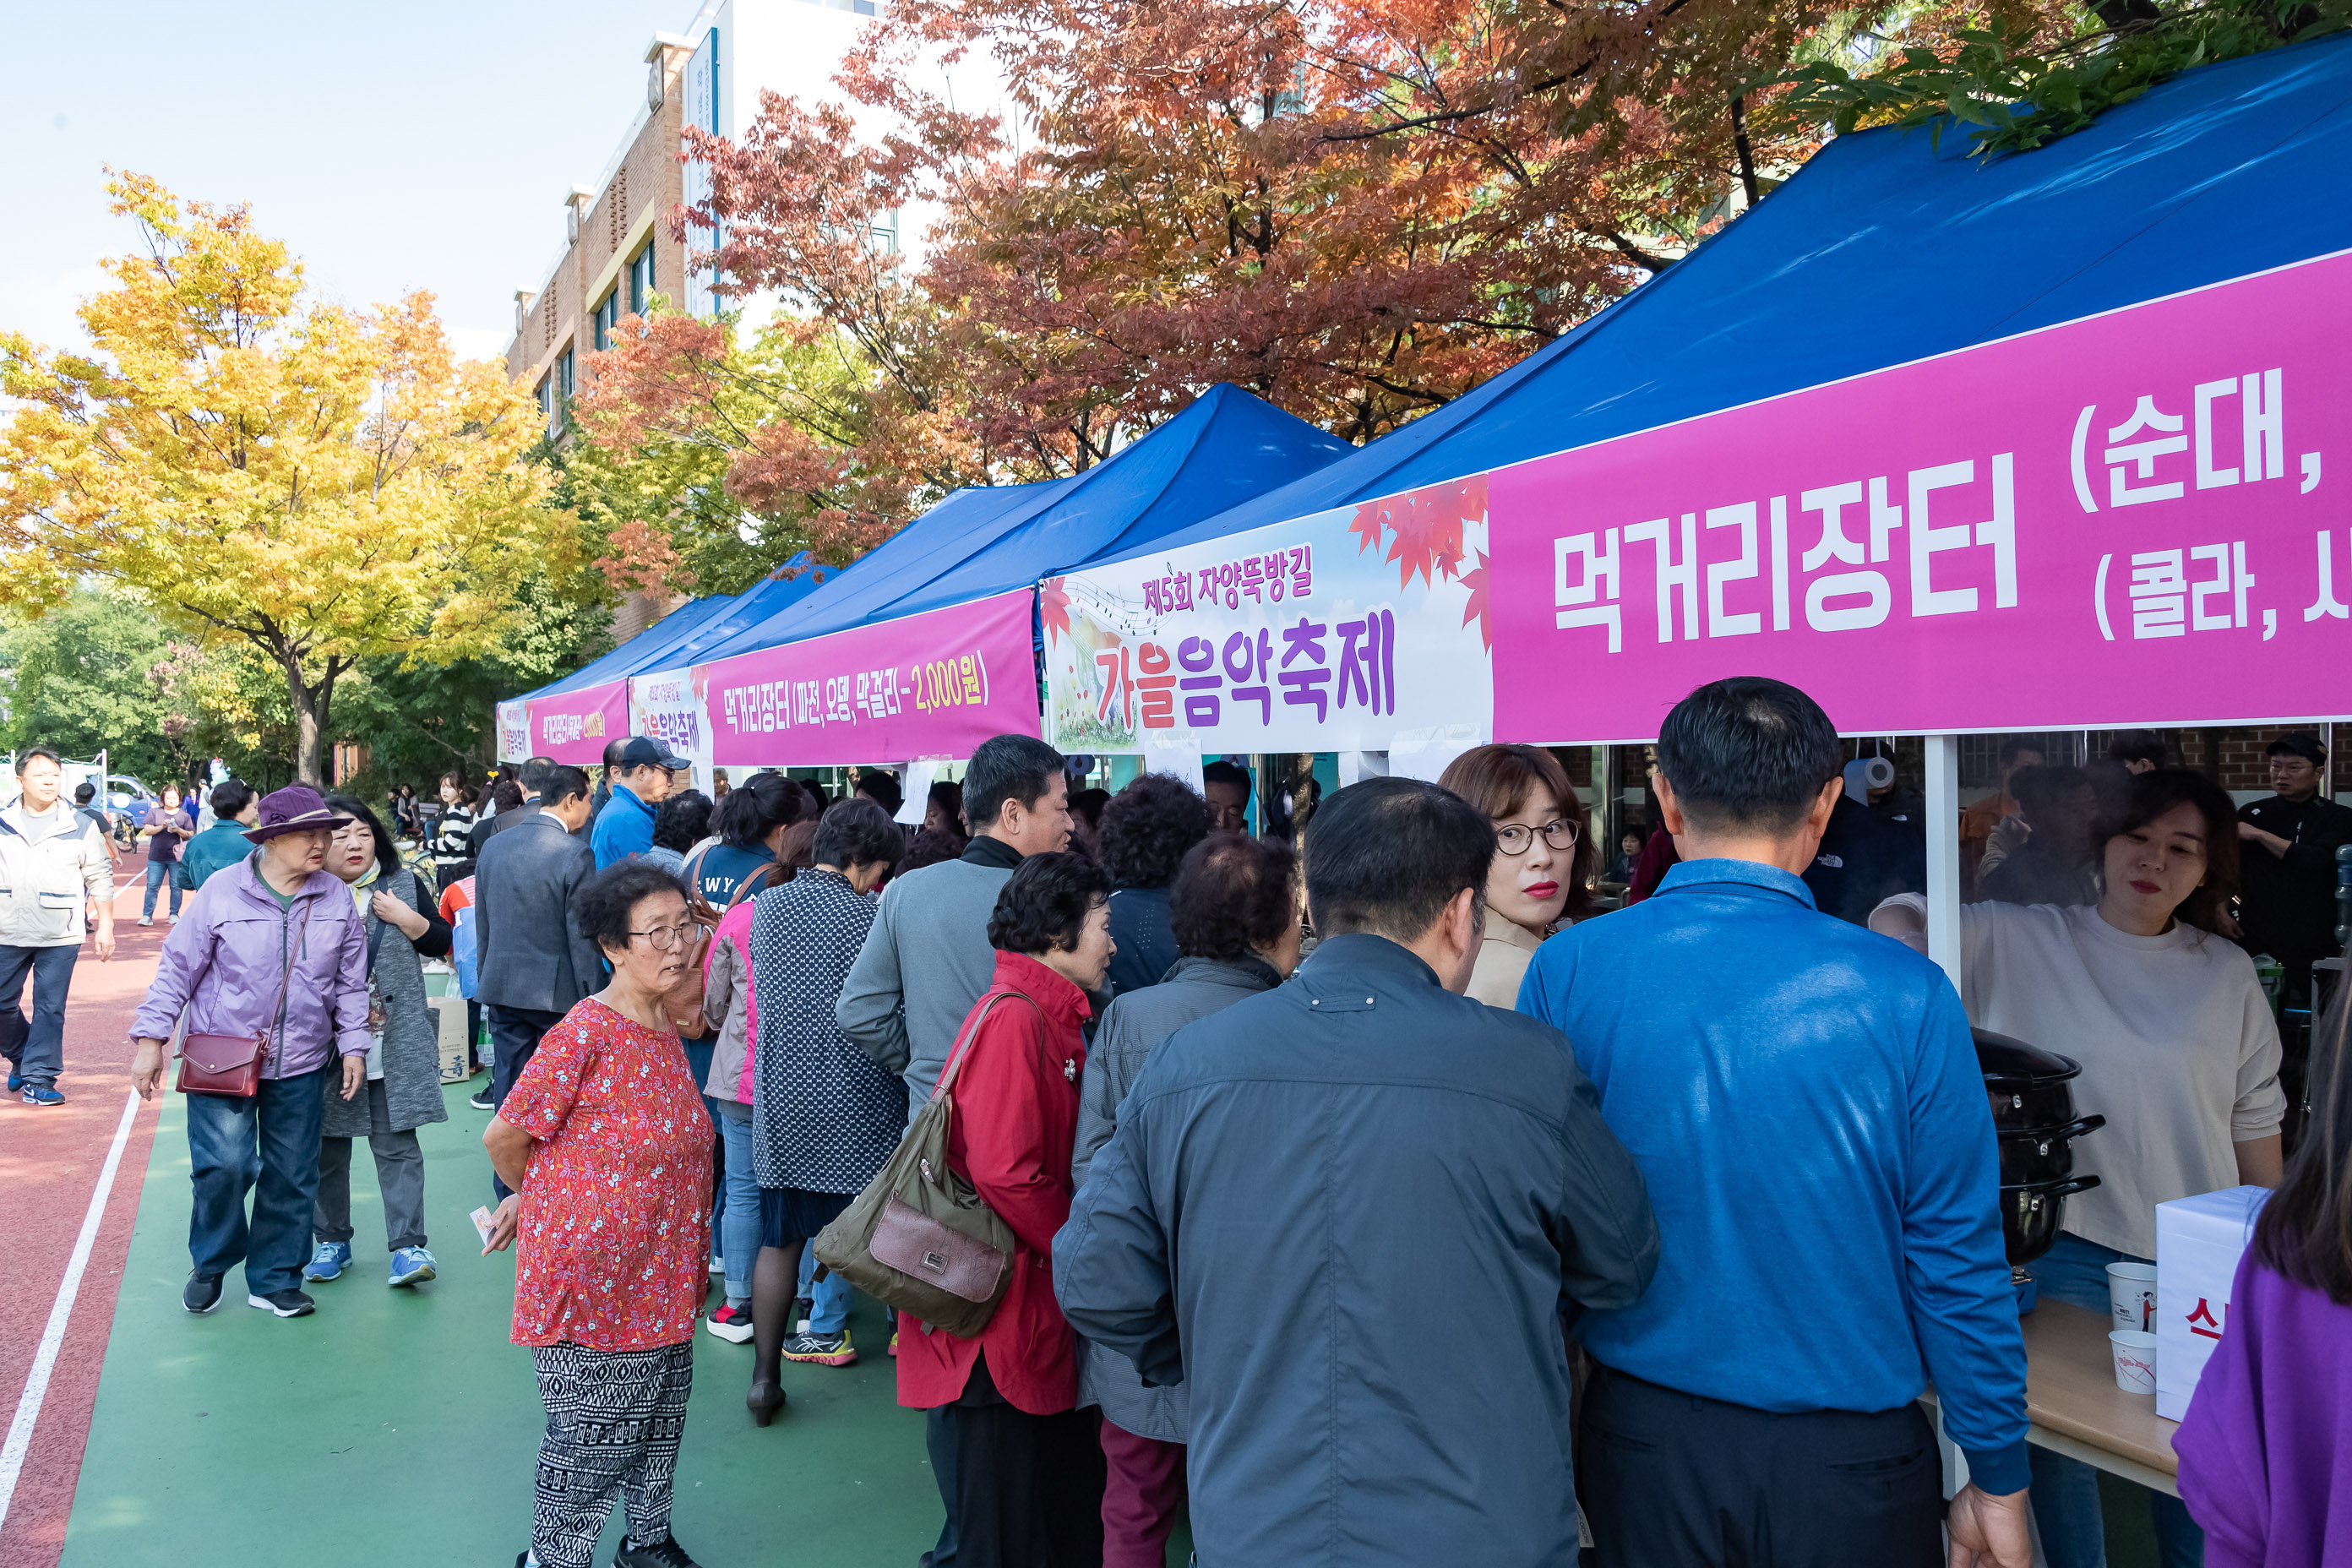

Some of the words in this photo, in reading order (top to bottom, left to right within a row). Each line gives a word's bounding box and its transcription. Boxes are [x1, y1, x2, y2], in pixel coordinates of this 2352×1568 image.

[1143, 572, 1194, 617] 제5회
[1199, 546, 1311, 610] 자양뚝방길
[1554, 451, 2019, 654] 먹거리장터
[723, 679, 791, 735] 먹거리장터
[1097, 608, 1396, 731] 가을음악축제
